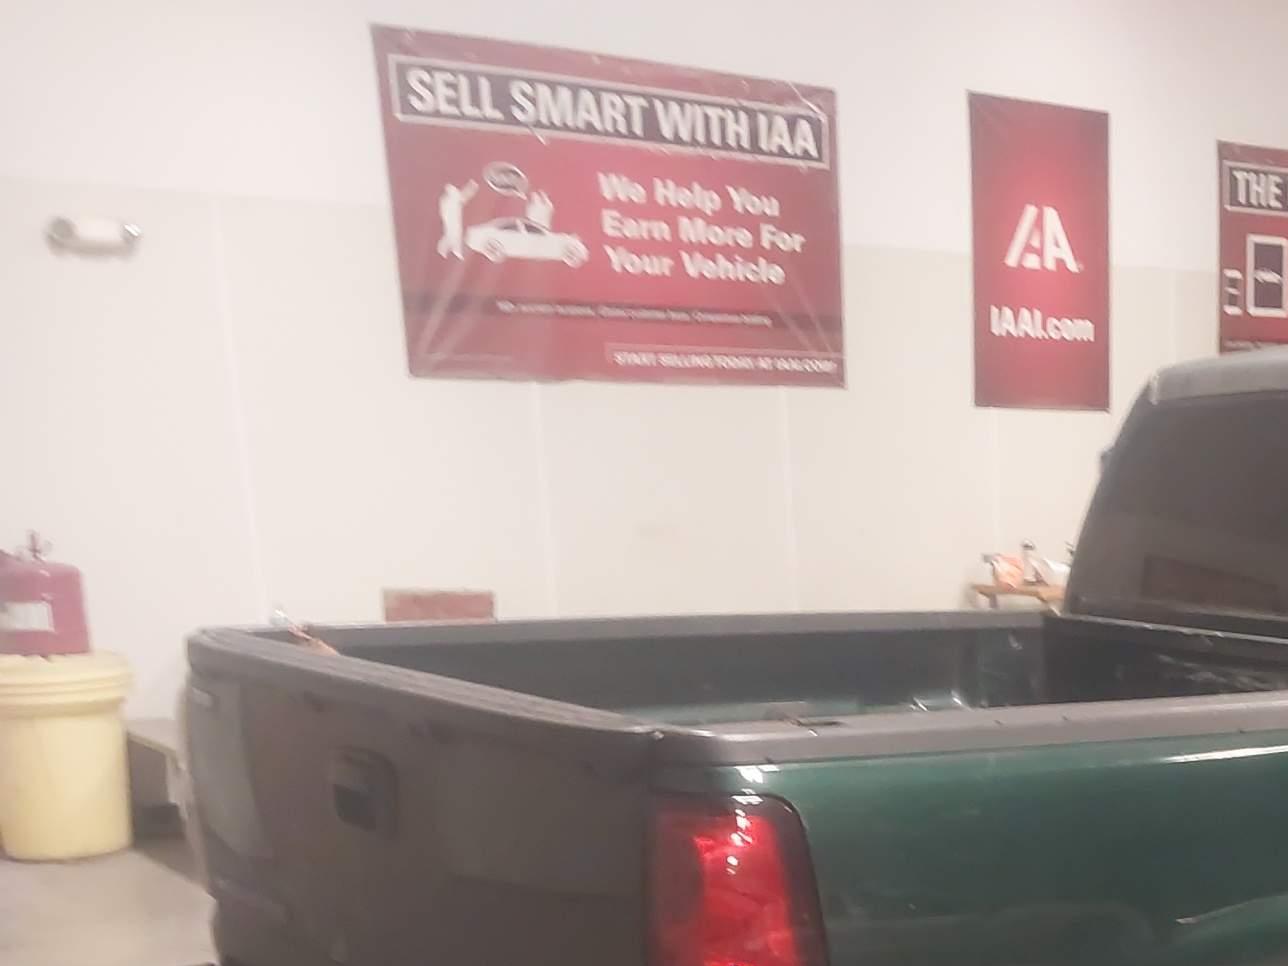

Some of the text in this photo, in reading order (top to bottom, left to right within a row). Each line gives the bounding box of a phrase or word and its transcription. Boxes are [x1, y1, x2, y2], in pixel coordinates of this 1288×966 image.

[405, 67, 819, 158] SELL SMART WITH IAA
[597, 171, 780, 217] We Help You
[1232, 170, 1283, 209] THE
[601, 208, 806, 253] Earn More For
[604, 244, 786, 286] Your Vehicle
[990, 305, 1095, 342] IAAI.com
